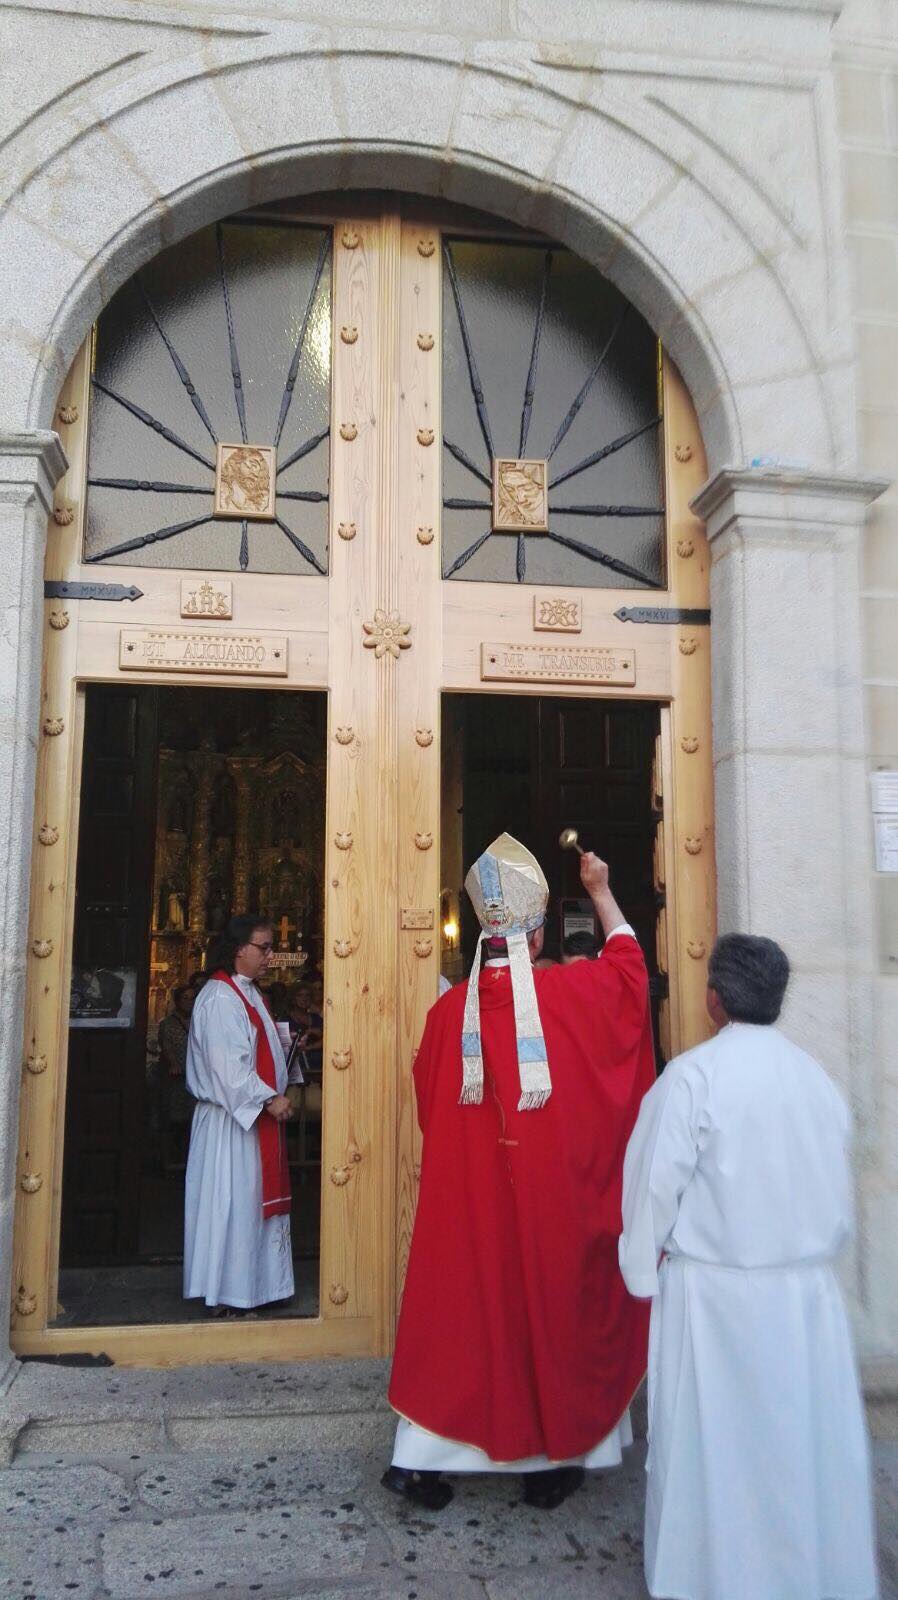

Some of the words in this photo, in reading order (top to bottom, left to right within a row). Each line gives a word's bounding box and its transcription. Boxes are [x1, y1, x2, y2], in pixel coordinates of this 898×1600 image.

[142, 640, 165, 657] ET
[184, 642, 266, 662] ALIQUANDO
[503, 652, 524, 668] ME
[539, 654, 616, 673] TRANSIBIS
